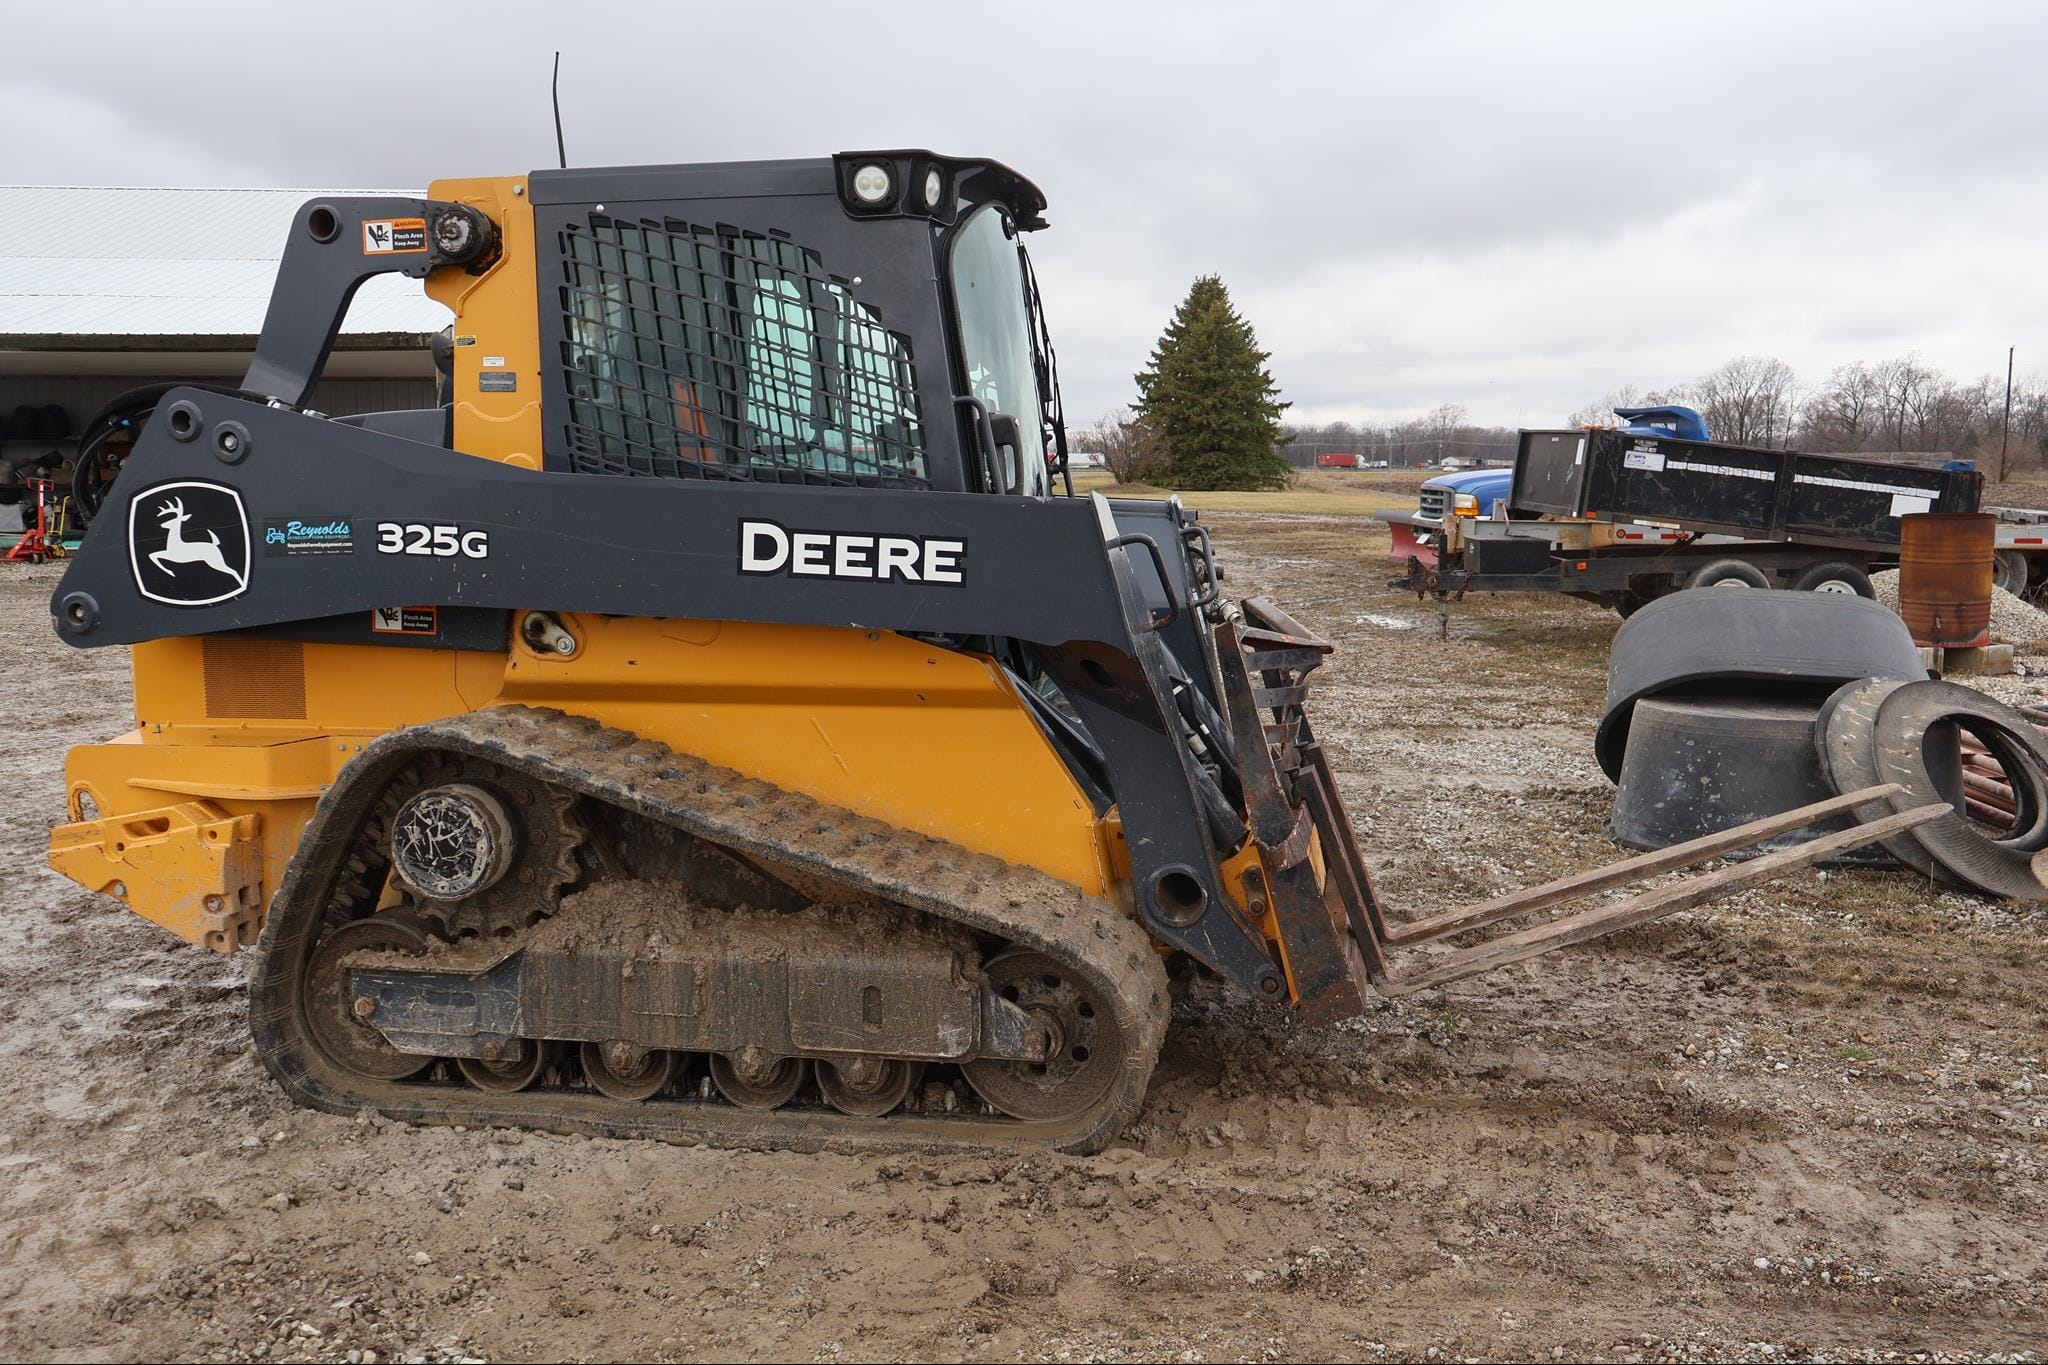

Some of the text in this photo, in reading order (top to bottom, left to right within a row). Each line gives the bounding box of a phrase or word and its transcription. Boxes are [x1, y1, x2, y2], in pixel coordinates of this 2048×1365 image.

[287, 521, 350, 538] Reynolds
[378, 523, 487, 558] 325G
[742, 522, 963, 582] DEERE
